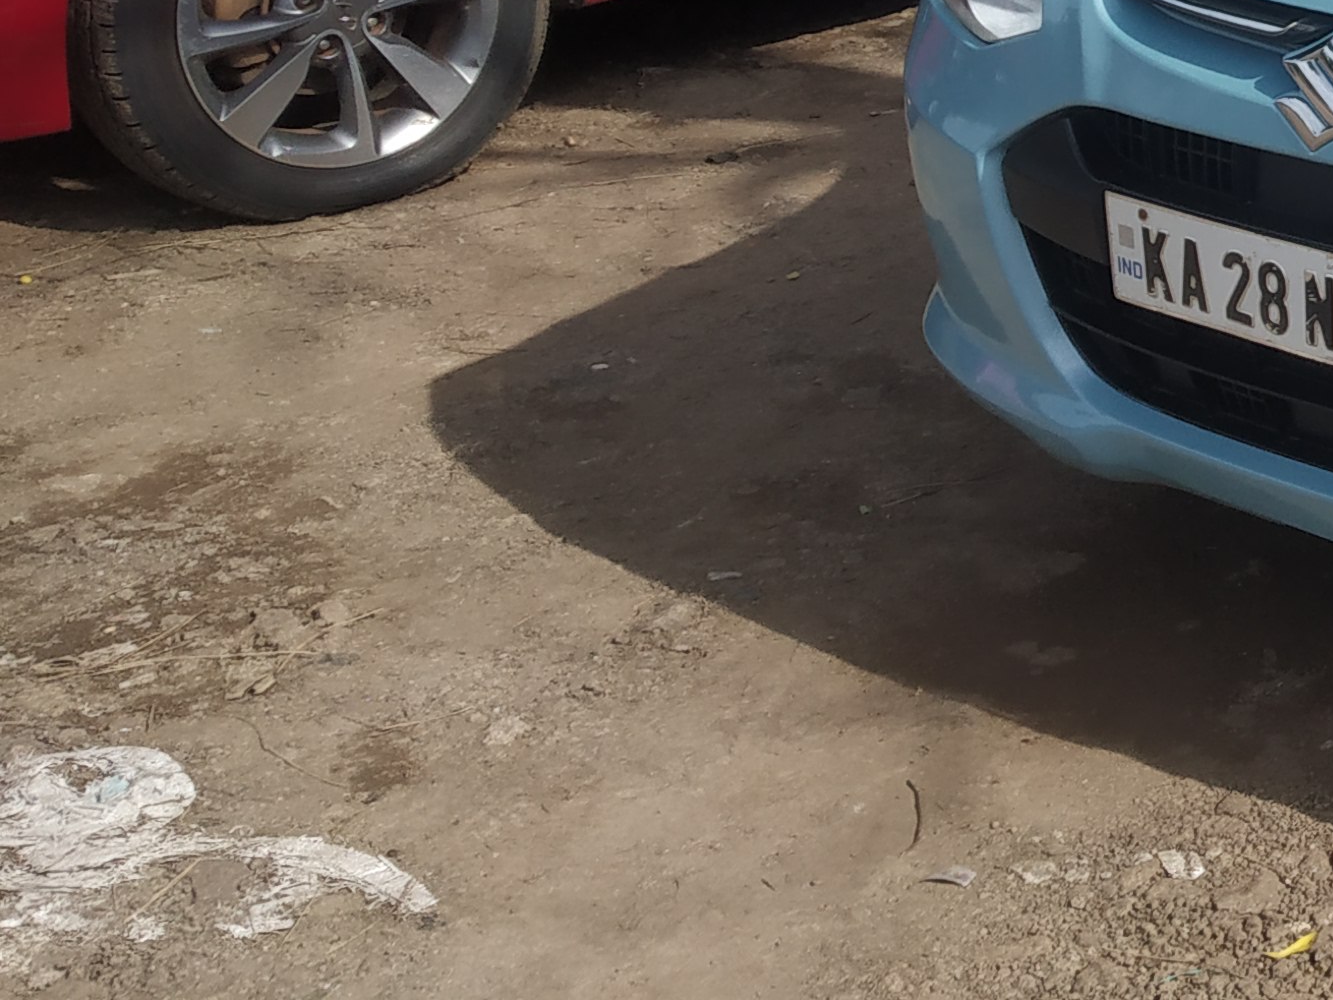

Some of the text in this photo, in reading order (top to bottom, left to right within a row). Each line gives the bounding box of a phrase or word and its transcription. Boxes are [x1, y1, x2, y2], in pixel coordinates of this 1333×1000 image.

[1117, 255, 1144, 281] IND
[1141, 224, 1210, 313] KA
[1221, 250, 1290, 336] 28
